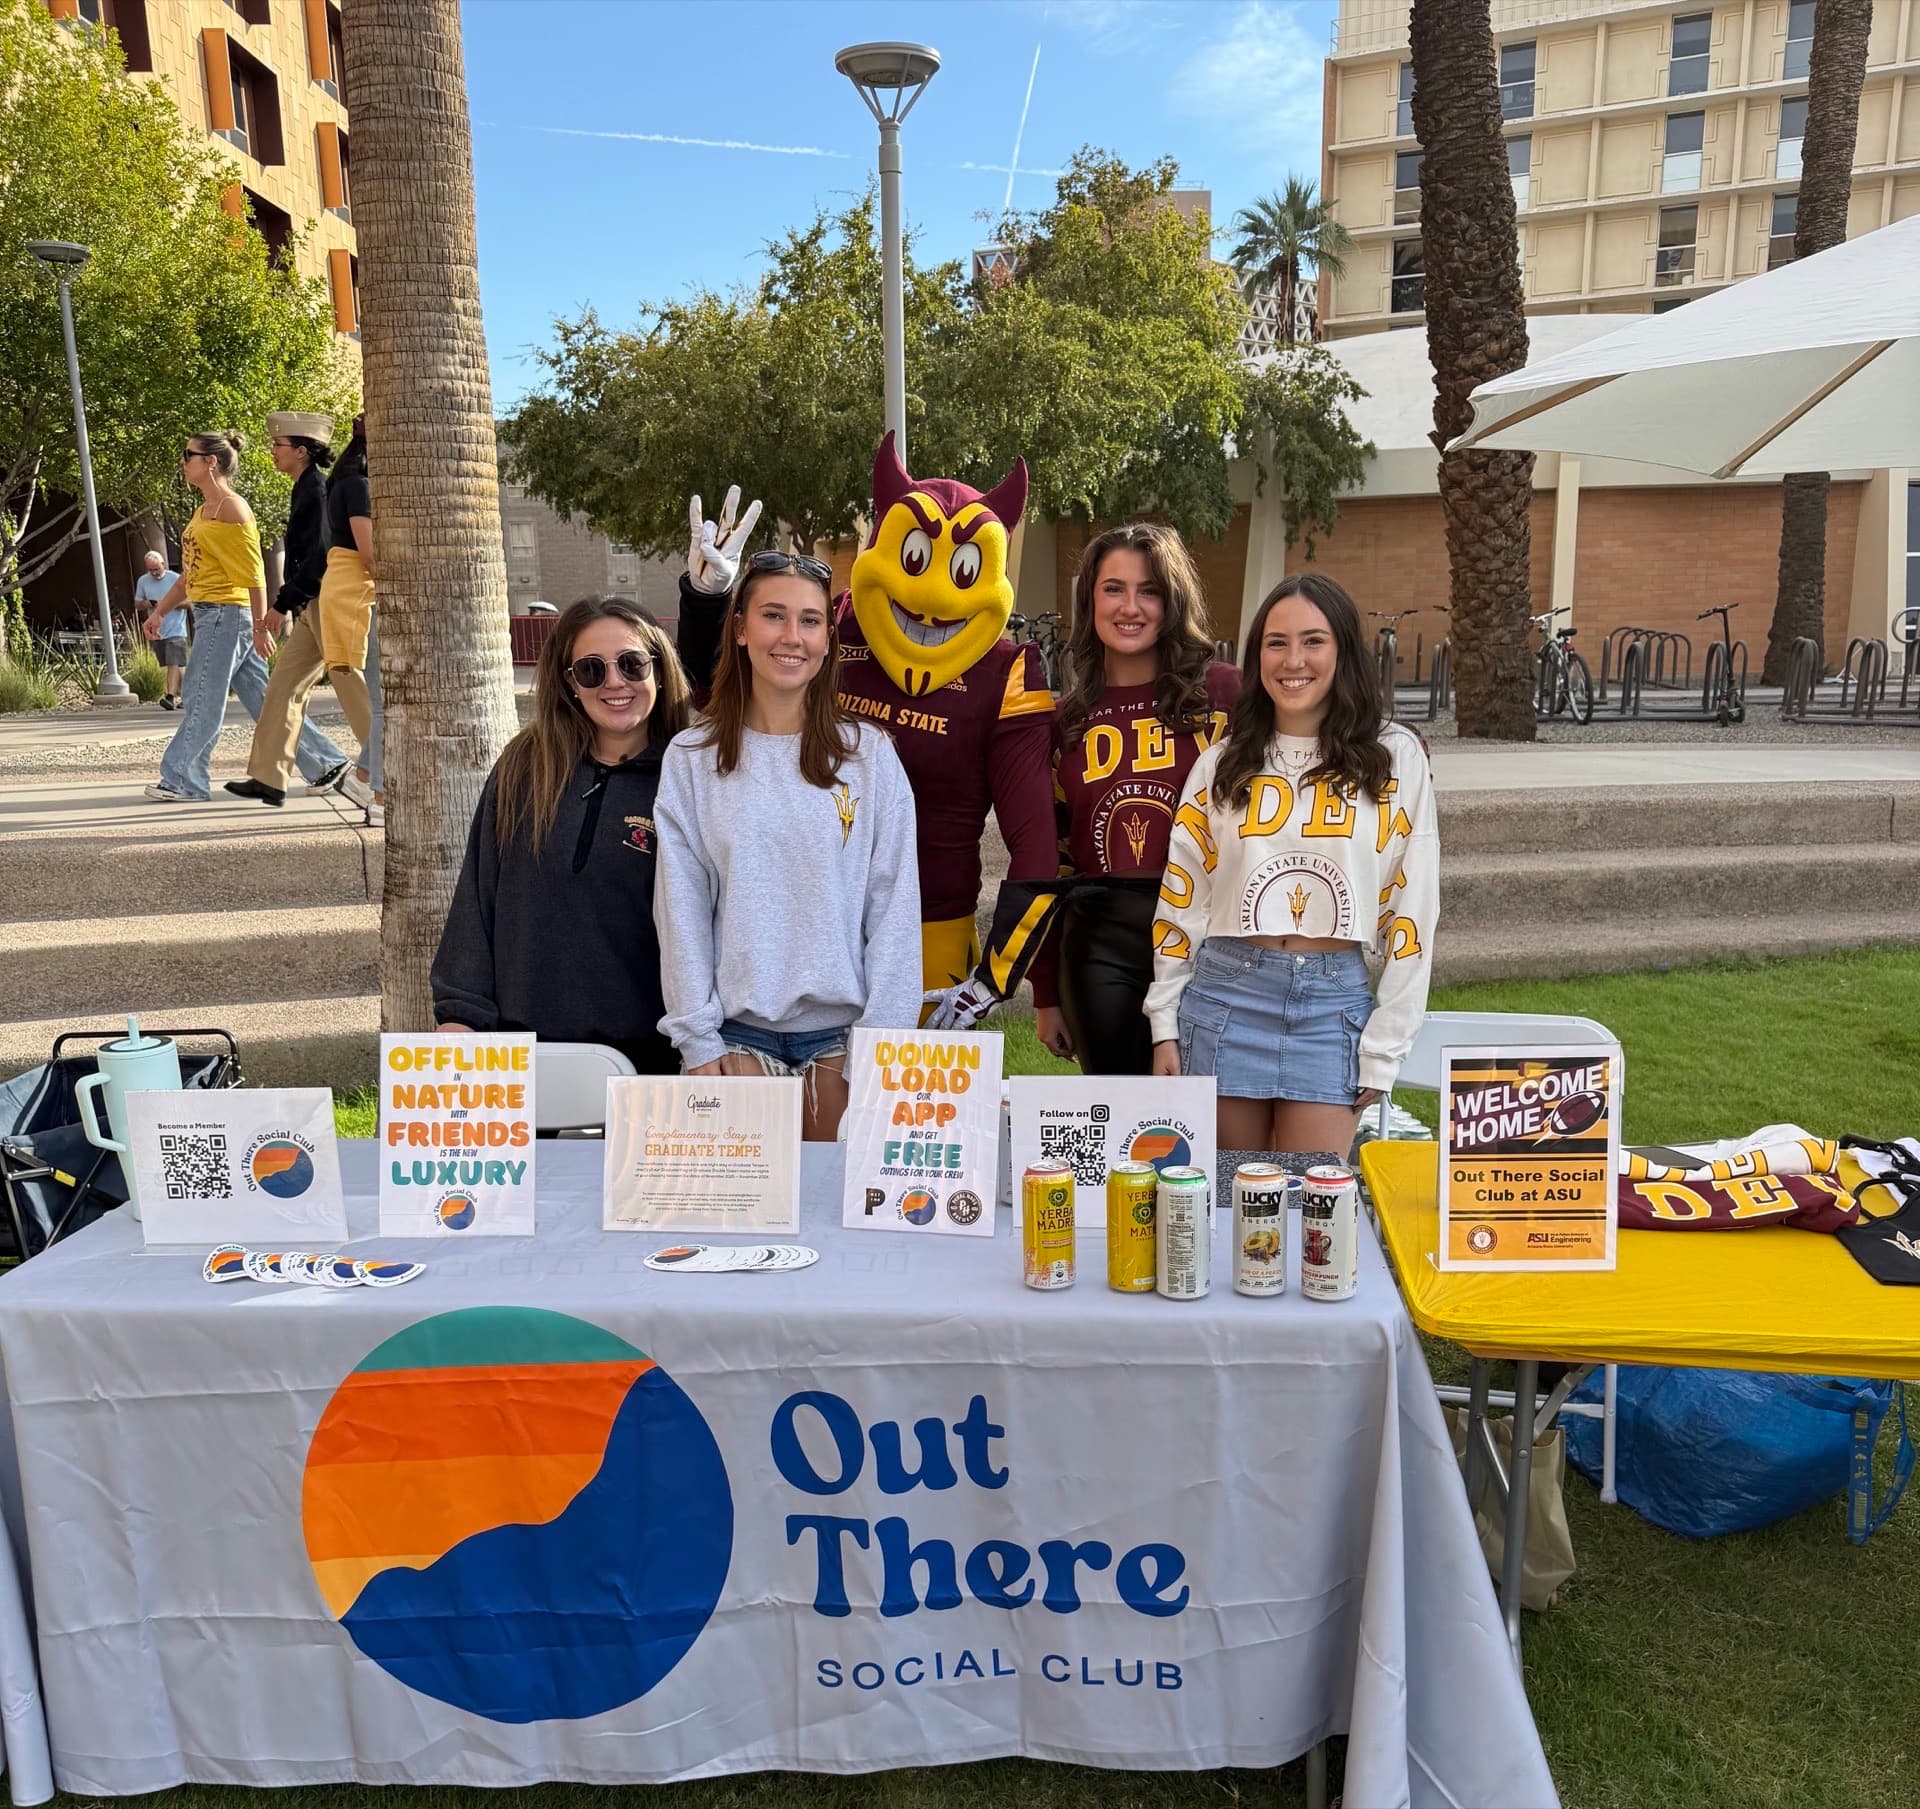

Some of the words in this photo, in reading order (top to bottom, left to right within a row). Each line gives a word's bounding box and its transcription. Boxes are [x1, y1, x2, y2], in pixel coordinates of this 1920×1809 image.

[837, 692, 891, 721] RIZONA
[897, 708, 949, 735] STATE
[1119, 702, 1145, 713] THE
[1293, 750, 1323, 760] THE
[1105, 784, 1143, 809] STATE
[1242, 873, 1267, 931] ARIZONA
[1266, 855, 1308, 874] STATE
[1312, 856, 1351, 932] UNIVERSITY
[388, 1046, 530, 1072] OFFLINE
[874, 1041, 981, 1070] DOWN
[453, 1072, 462, 1081] IN
[881, 1067, 971, 1094] LOAD
[392, 1083, 525, 1109] NATURE
[916, 1092, 931, 1101] OUR
[1456, 1064, 1604, 1119] WELCOME
[687, 1094, 721, 1113] Graduate
[450, 1110, 468, 1118] WITH
[892, 1101, 957, 1128] APP
[1040, 1109, 1074, 1118] Follow
[195, 1122, 226, 1130] Member
[387, 1121, 530, 1148] FRIENDS
[645, 1125, 719, 1142] Complimentary
[722, 1126, 748, 1142] Stay
[1456, 1106, 1542, 1149] HOME
[256, 1129, 291, 1144] Social
[293, 1133, 316, 1154] Club
[909, 1130, 924, 1140] AND
[925, 1131, 938, 1140] GET
[1119, 1128, 1138, 1157] There
[1138, 1117, 1172, 1130] Social
[1174, 1121, 1195, 1141] Club
[241, 1142, 258, 1174] There
[440, 1149, 447, 1158] IS
[449, 1149, 461, 1158] THE
[645, 1144, 714, 1157] GRADUATE
[718, 1145, 762, 1158] TEMPE
[883, 1141, 963, 1168] FREE
[391, 1160, 527, 1186] LUXURY
[880, 1167, 909, 1177] OUTINGS
[944, 1170, 964, 1179] CREW
[1453, 1169, 1485, 1182] Out
[1490, 1169, 1543, 1182] There
[1548, 1168, 1604, 1182] Social
[243, 1174, 258, 1192] Out
[1241, 1190, 1283, 1205] LUCKY
[1302, 1191, 1340, 1208] UCKY
[1475, 1188, 1515, 1202] Club
[1520, 1190, 1538, 1201] at
[1543, 1188, 1582, 1201] ASU
[1040, 1206, 1074, 1220] YERBA
[1241, 1217, 1281, 1225] ENERGY
[1037, 1218, 1075, 1231] MADRE
[1304, 1218, 1336, 1228] NERGY
[1527, 1232, 1549, 1243] ASU
[1550, 1236, 1591, 1244] Engineering
[769, 1390, 1010, 1496] Out
[785, 1514, 1190, 1618] There
[816, 1648, 1017, 1690] SOCIAL
[1041, 1653, 1184, 1691] CLUB
